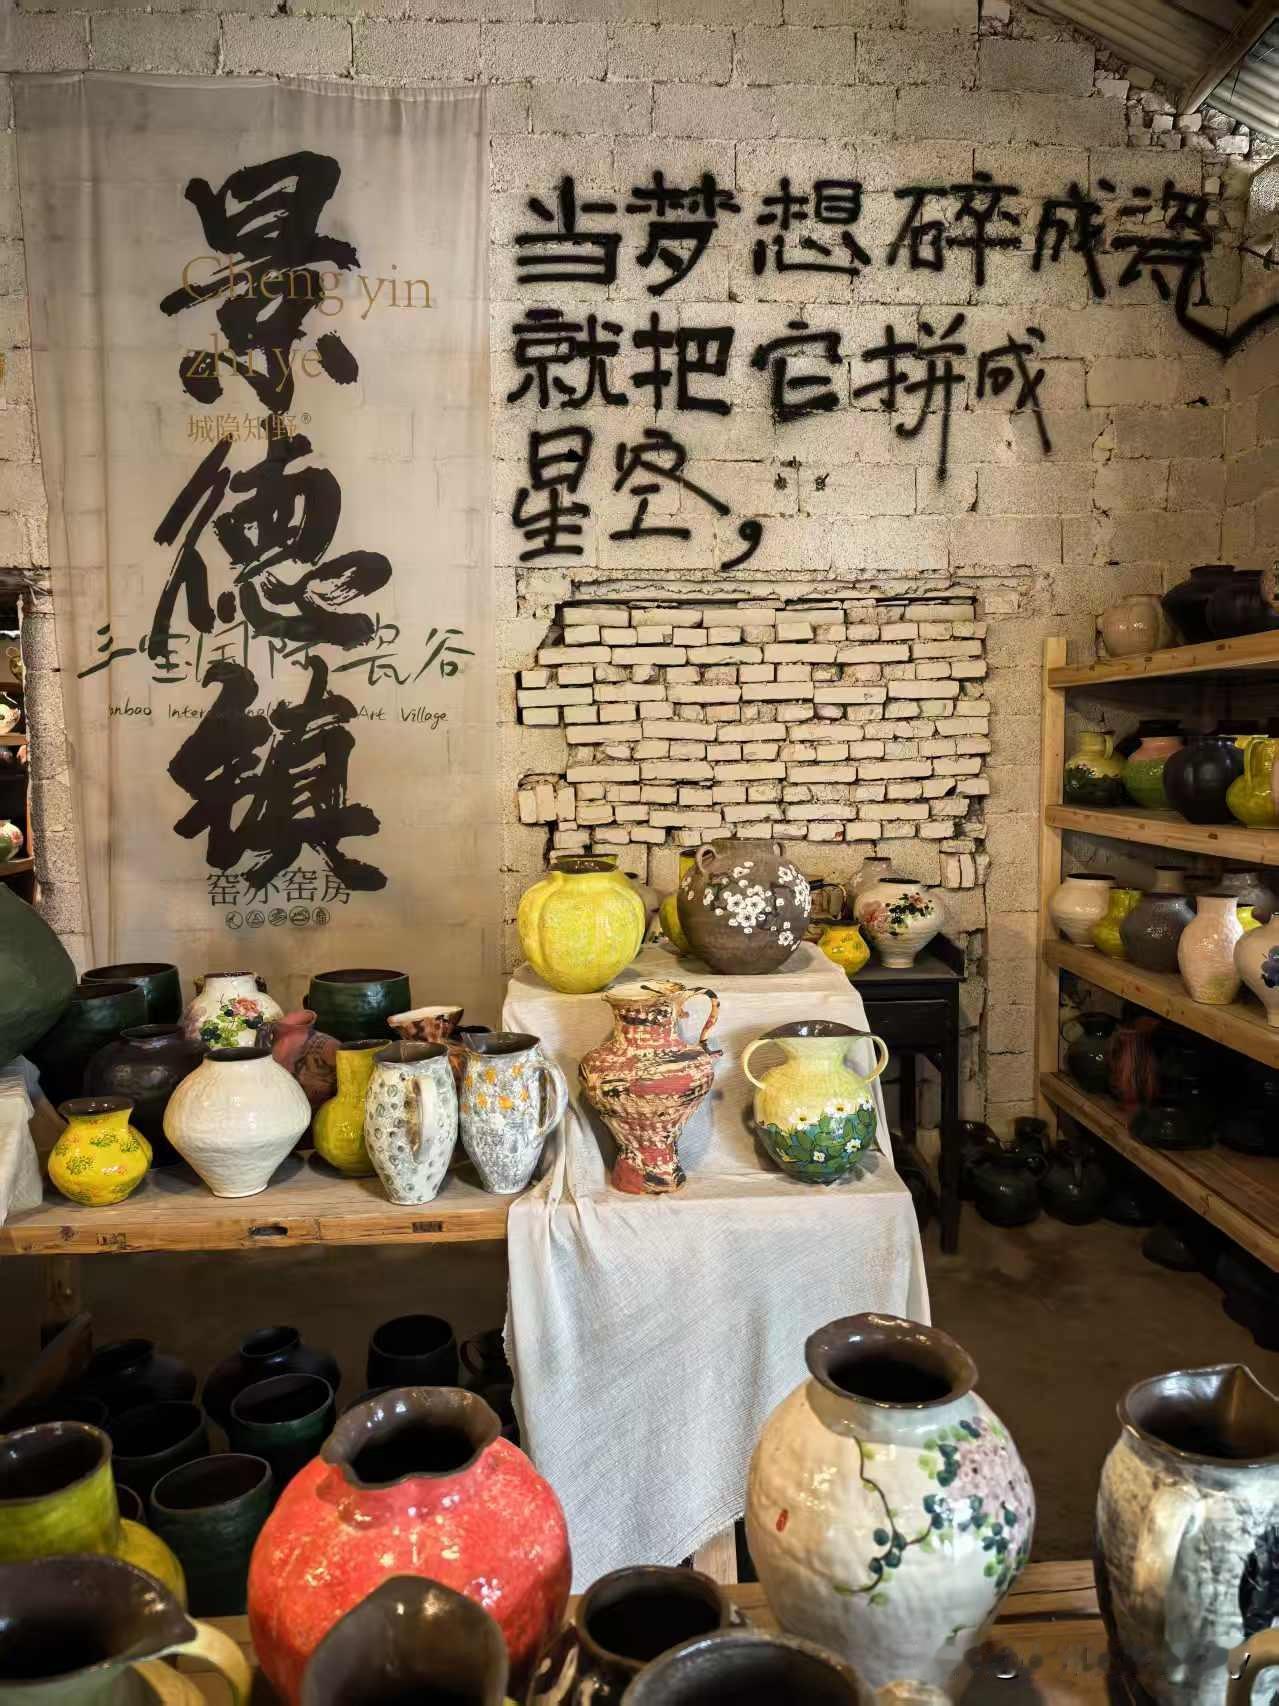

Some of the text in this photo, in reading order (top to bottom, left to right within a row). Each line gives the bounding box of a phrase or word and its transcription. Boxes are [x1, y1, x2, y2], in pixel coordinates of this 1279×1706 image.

[182, 255, 437, 320] Cheng yin
[186, 333, 263, 379] zhi
[400, 705, 449, 730] Village
